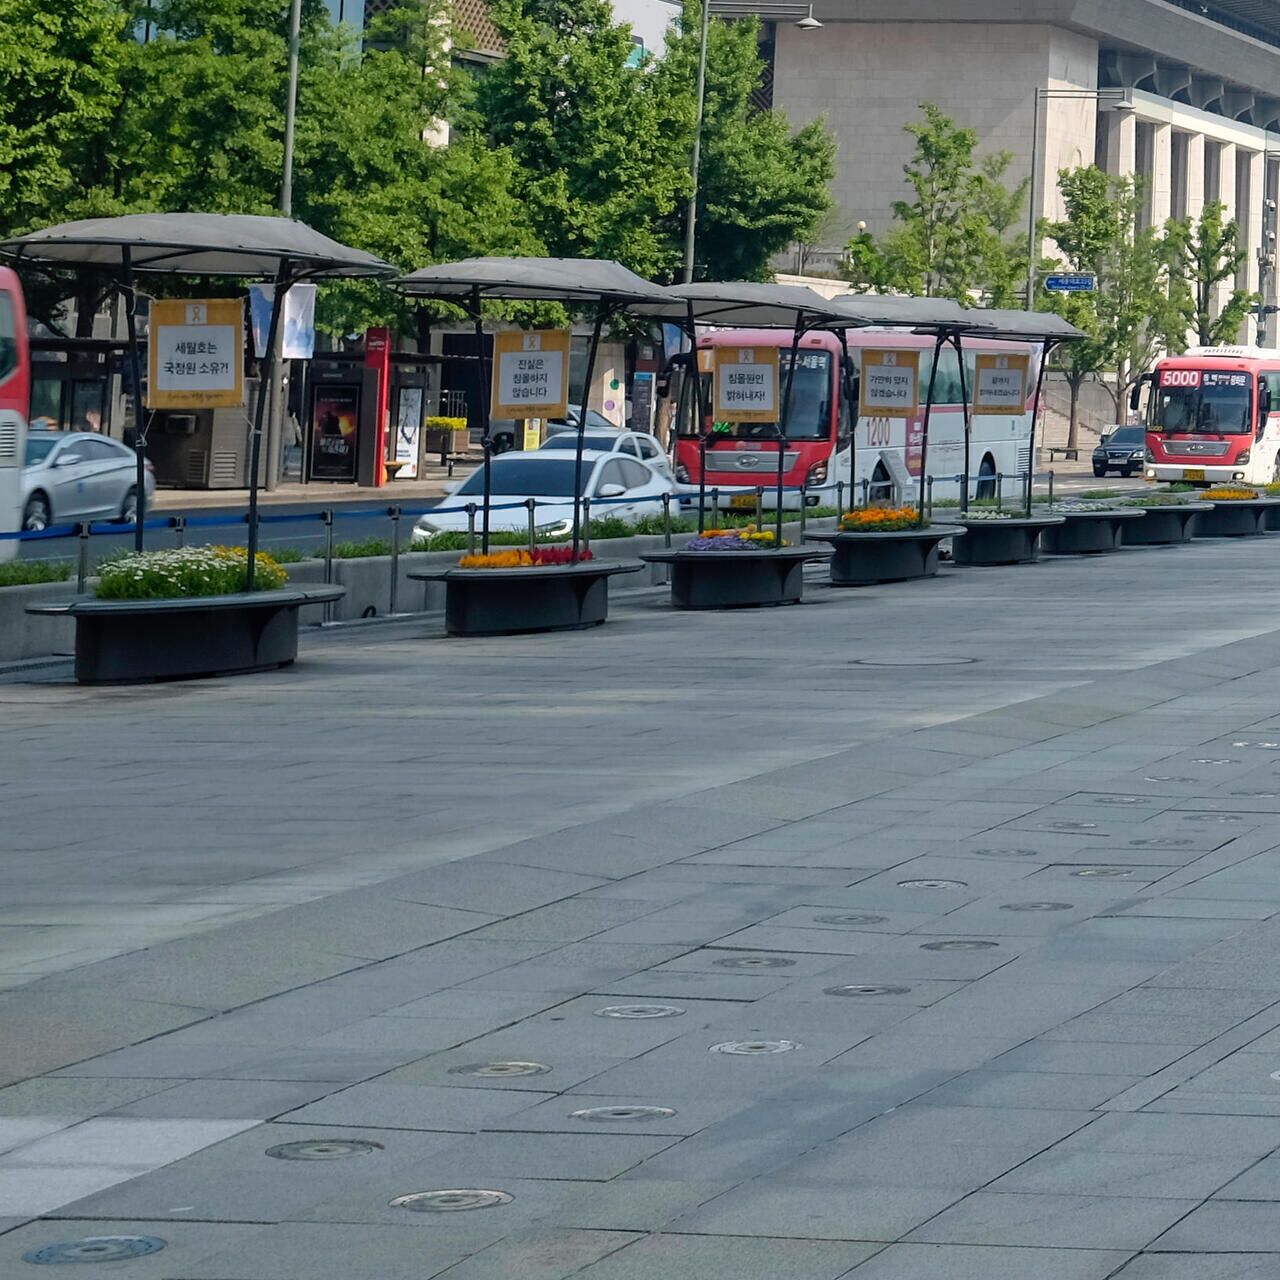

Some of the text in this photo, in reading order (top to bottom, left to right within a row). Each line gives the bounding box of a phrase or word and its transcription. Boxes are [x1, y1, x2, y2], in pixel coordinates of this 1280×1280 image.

[176, 341, 217, 355] 세월호는
[164, 362, 229, 376] 국정원 소유?!
[518, 359, 544, 370] 진실은
[513, 373, 548, 385] 침몰하지
[729, 373, 764, 385] 침몰원인
[1163, 370, 1199, 386] 5000
[512, 387, 548, 399] 않습니다
[726, 390, 766, 401] 밝혀내자!
[866, 417, 890, 446] 1200
